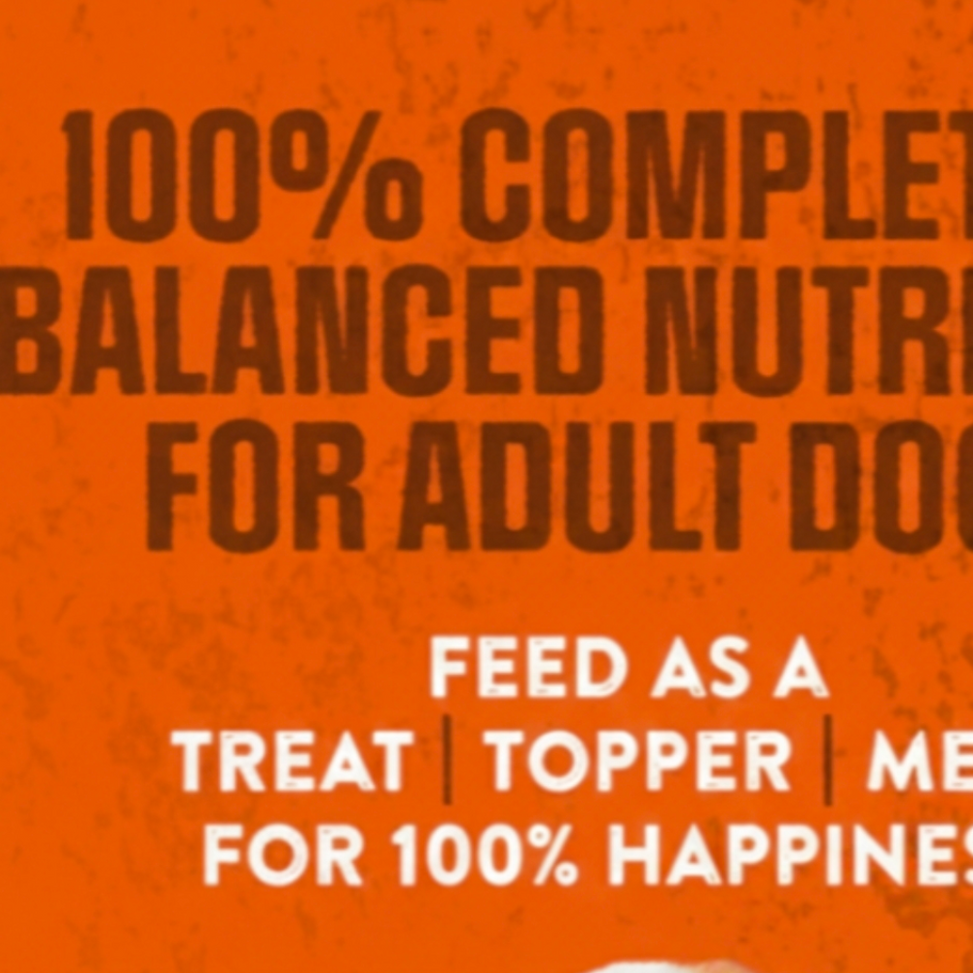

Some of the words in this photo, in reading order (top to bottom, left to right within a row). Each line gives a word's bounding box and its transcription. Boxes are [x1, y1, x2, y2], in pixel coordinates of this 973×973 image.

[61, 107, 423, 243] 100%
[0, 264, 604, 397] BALANCED
[146, 418, 366, 554] FOR
[397, 420, 757, 554] ADULT
[430, 635, 628, 698] FEED
[651, 635, 750, 699] AS
[774, 636, 830, 698] A
[170, 730, 414, 792] TREAT
[483, 730, 792, 792] TOPPER
[203, 823, 364, 886] FOR
[392, 823, 578, 886] 100%
